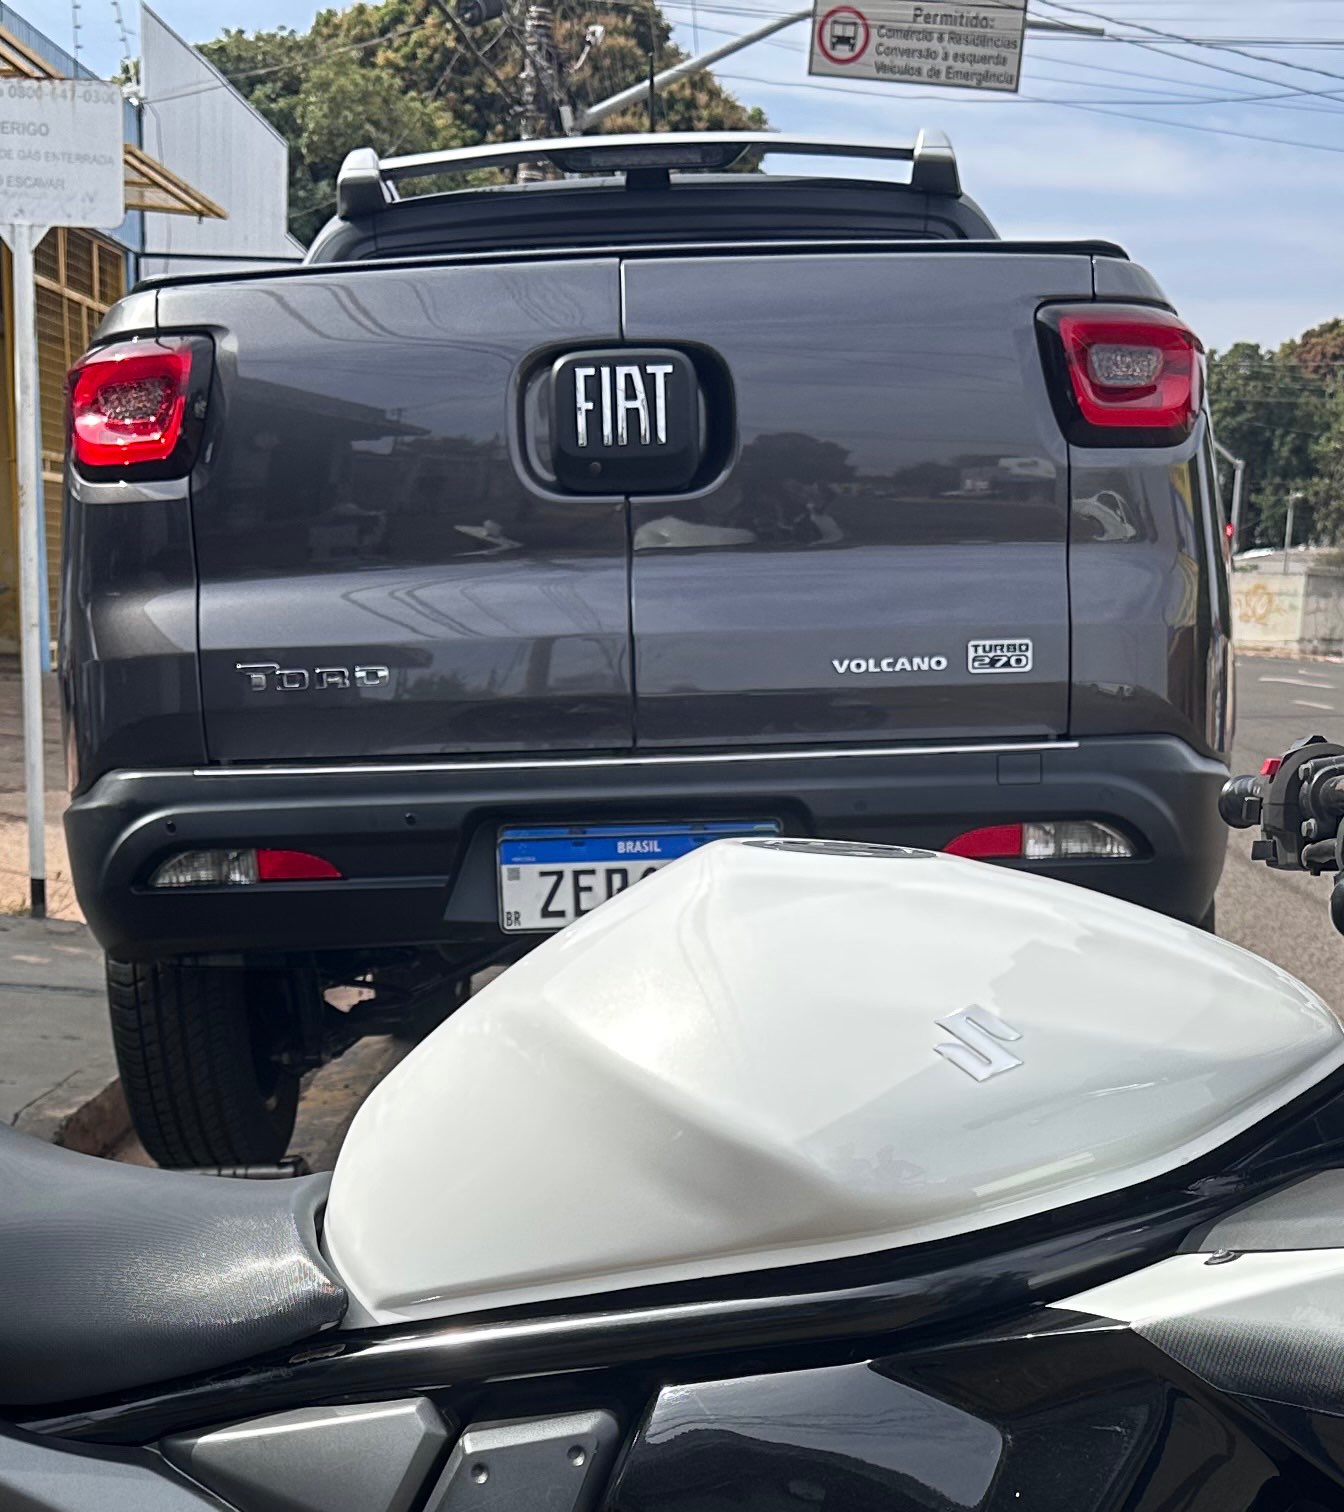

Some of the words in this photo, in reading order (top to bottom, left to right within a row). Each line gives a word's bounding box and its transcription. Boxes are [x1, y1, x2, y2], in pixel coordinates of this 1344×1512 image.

[912, 7, 995, 29] Permitido:
[574, 364, 674, 447] FIAT
[971, 643, 1029, 654] TURBO
[832, 656, 948, 674] VOLCANO
[972, 655, 1028, 669] 270
[235, 662, 390, 691] TORO
[616, 840, 662, 854] BRASIL
[539, 867, 657, 919] ZER
[505, 911, 521, 927] BR
